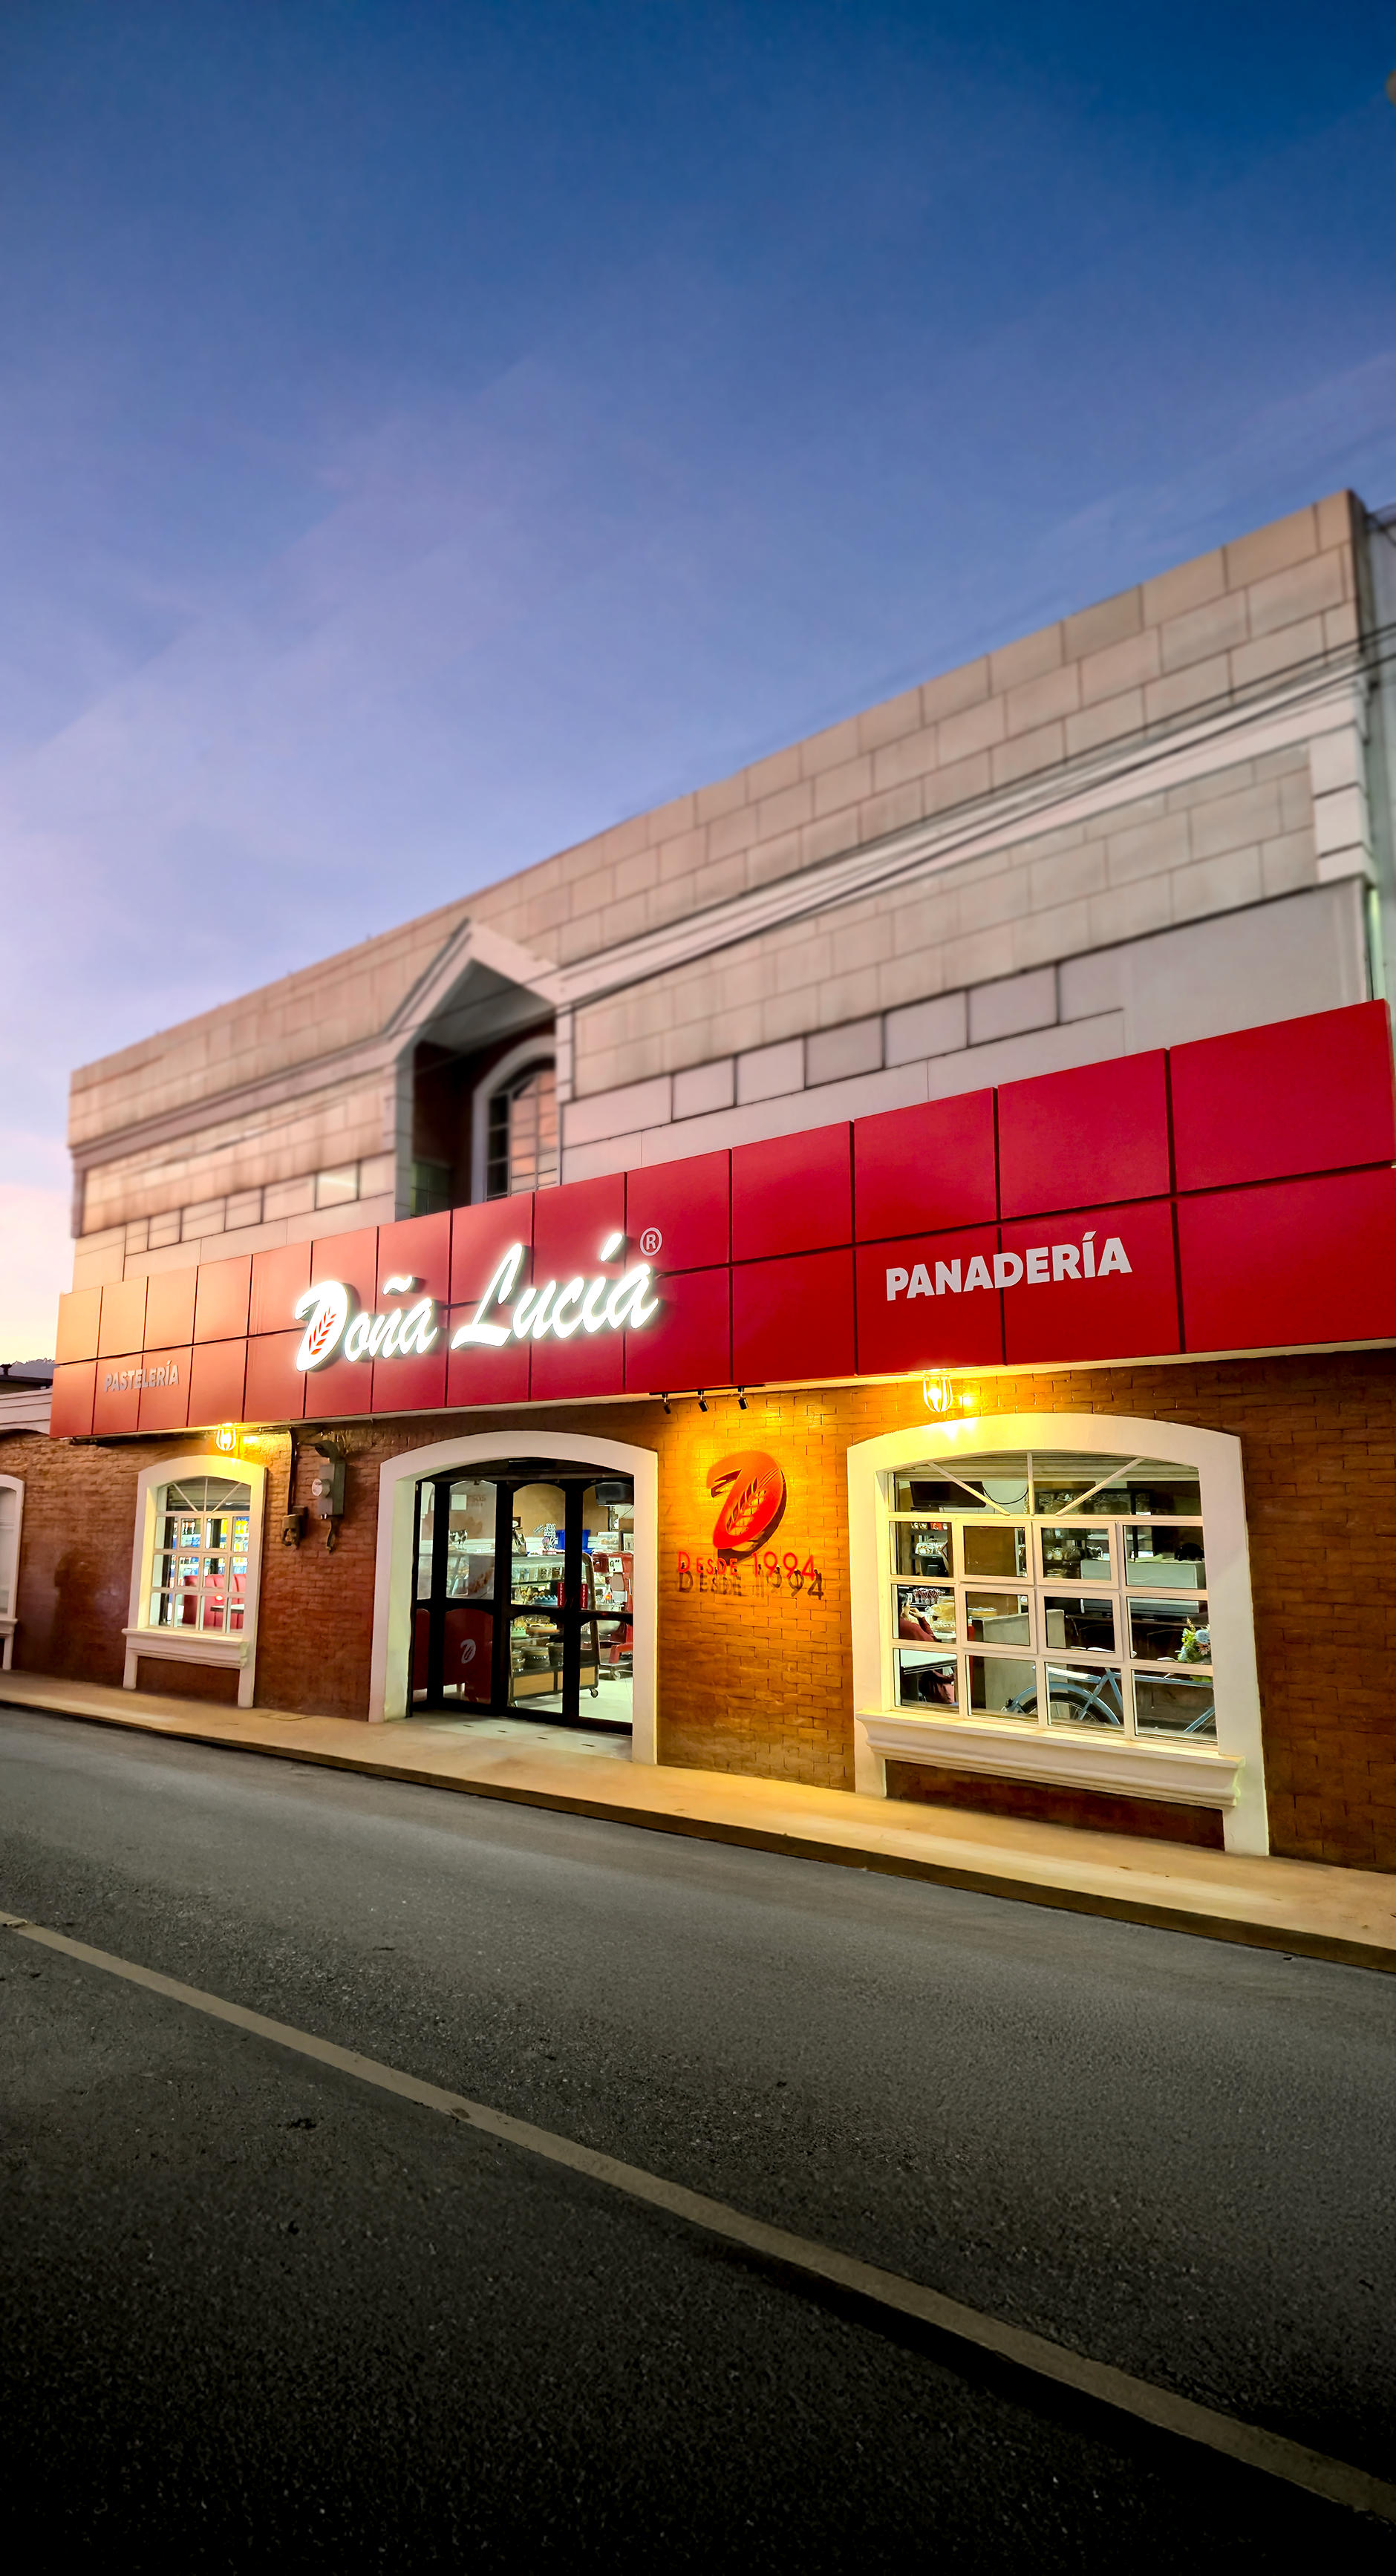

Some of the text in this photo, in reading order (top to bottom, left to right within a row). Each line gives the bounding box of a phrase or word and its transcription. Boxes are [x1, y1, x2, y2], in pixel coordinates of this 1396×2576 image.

[886, 1231, 1133, 1301] PANADERÍA
[294, 1275, 439, 1373] Doña
[450, 1232, 659, 1350] Lucía
[105, 1360, 180, 1393] PASTELERÍA
[751, 1551, 816, 1581] 1994
